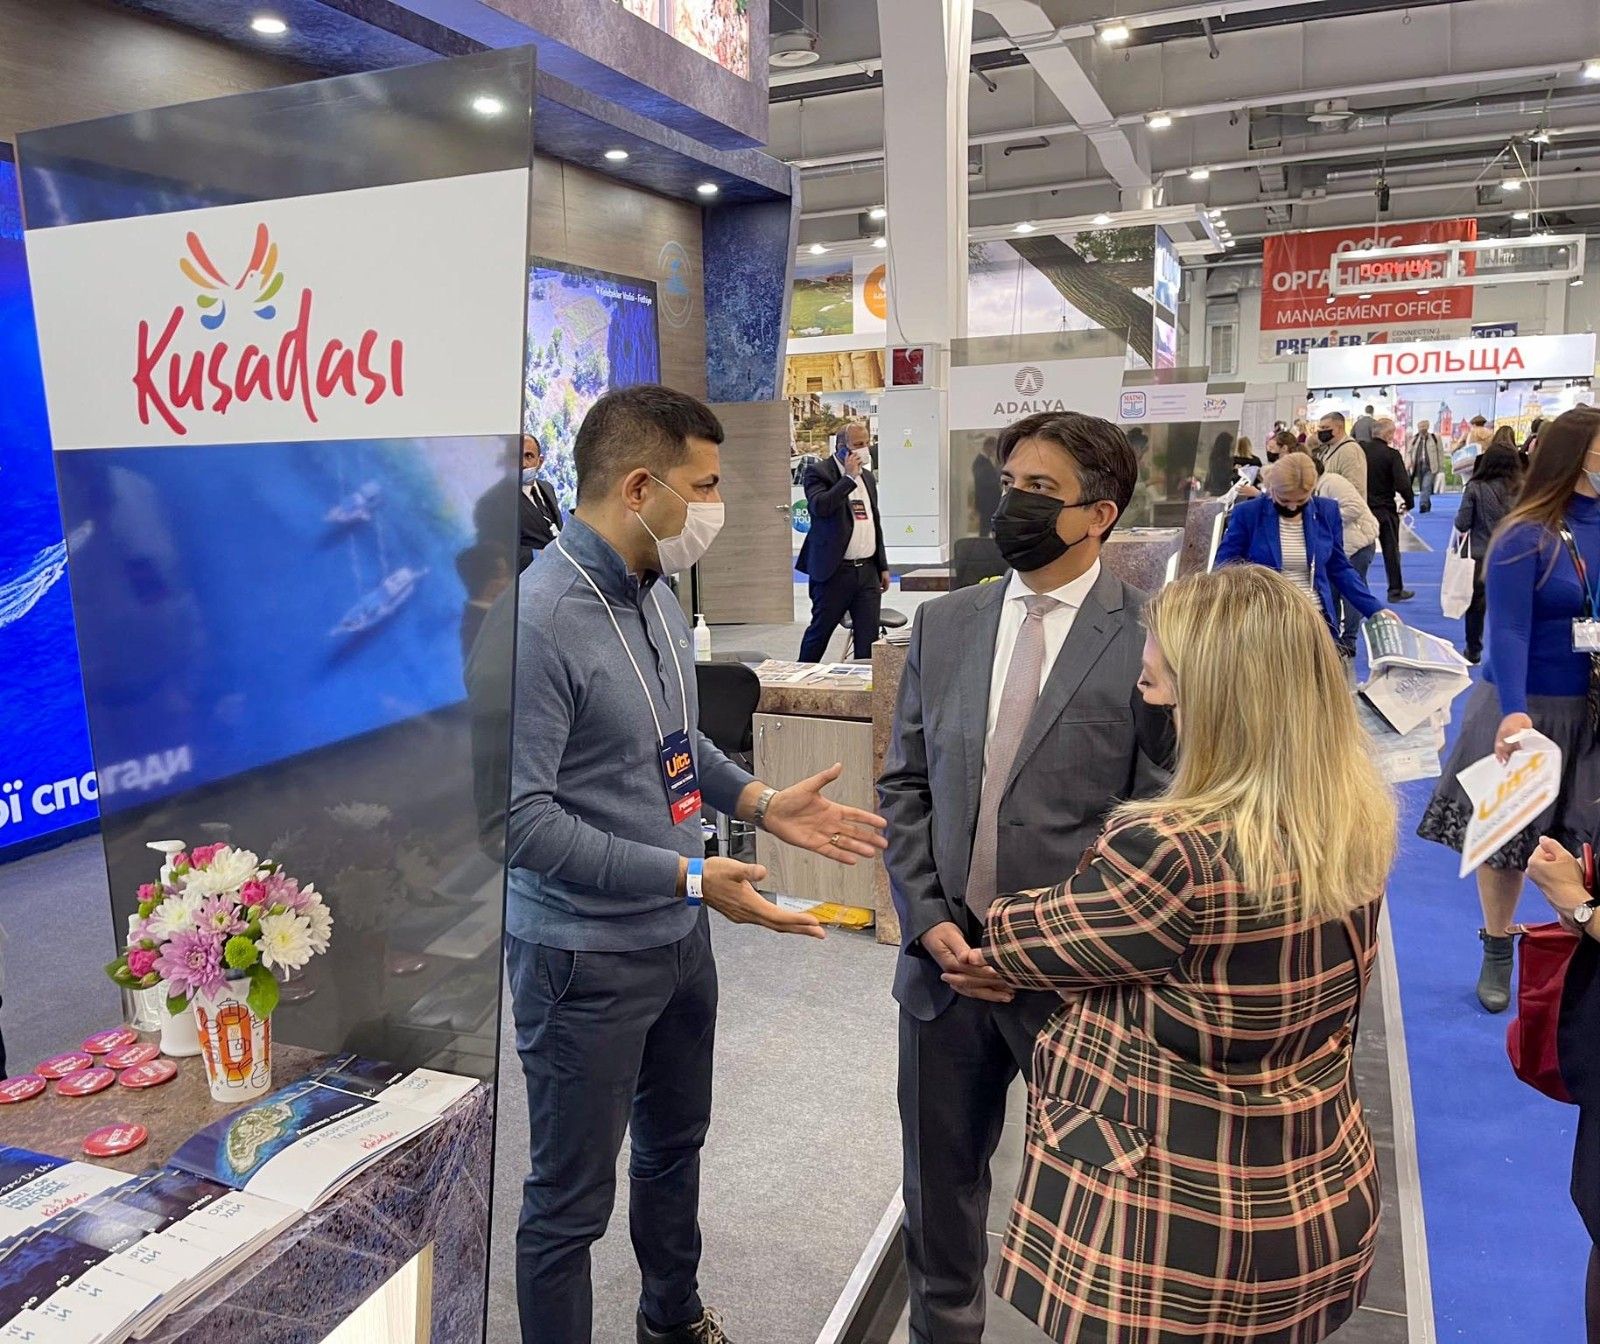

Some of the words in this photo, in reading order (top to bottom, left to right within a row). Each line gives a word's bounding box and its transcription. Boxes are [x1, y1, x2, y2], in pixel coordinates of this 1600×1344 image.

[1276, 303, 1393, 324] MANAGEMENT
[1394, 299, 1452, 317] OFFICE
[134, 288, 404, 435] Kuşadası
[1373, 347, 1525, 376] ПОЛЬЩА
[993, 399, 1066, 415] ADALYA
